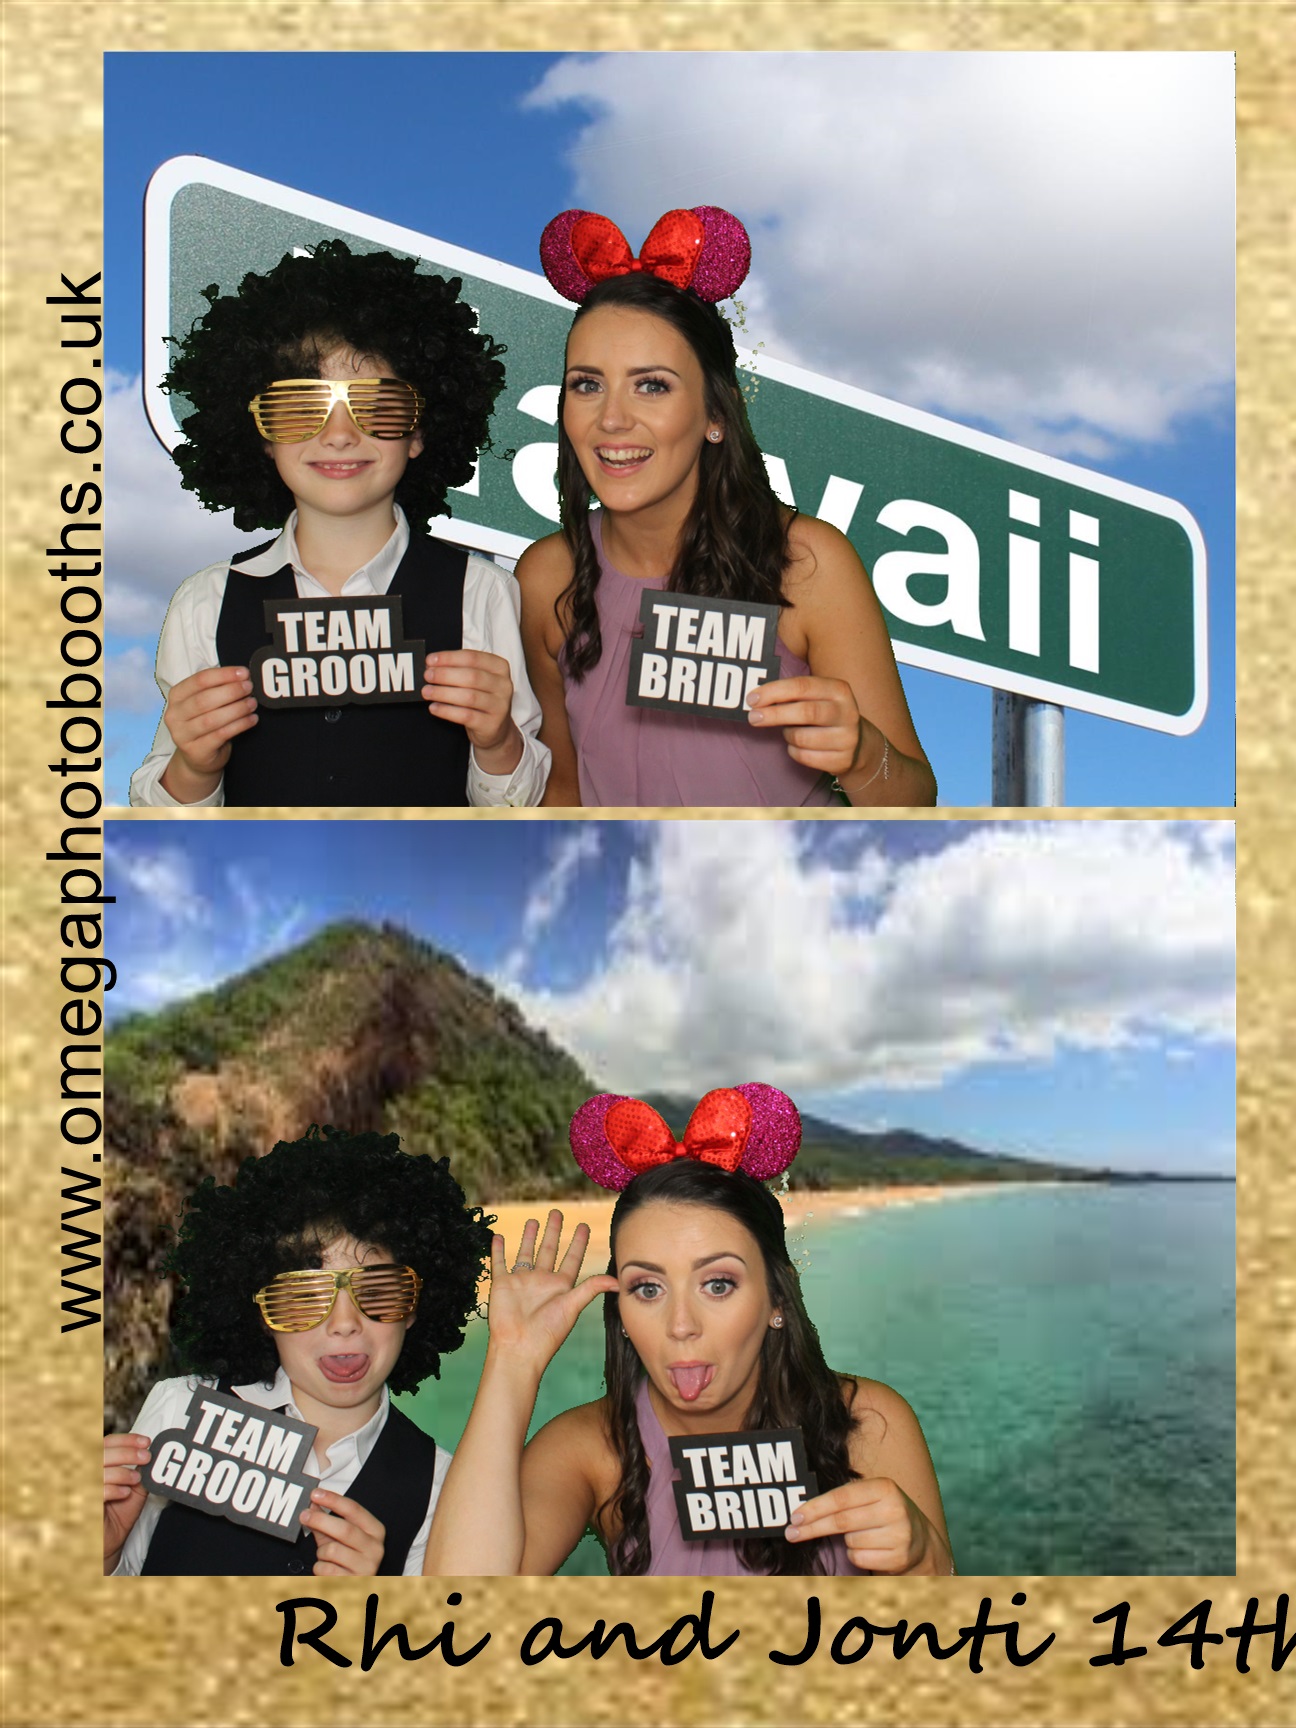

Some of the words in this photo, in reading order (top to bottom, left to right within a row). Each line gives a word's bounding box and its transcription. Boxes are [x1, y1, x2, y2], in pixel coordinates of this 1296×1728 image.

[277, 608, 391, 652] TEAM
[652, 604, 766, 662] TEAM
[261, 652, 415, 698] GROOM
[192, 1400, 303, 1475] TEAM
[682, 1440, 797, 1488] TEAM
[151, 1440, 304, 1528] GROOM
